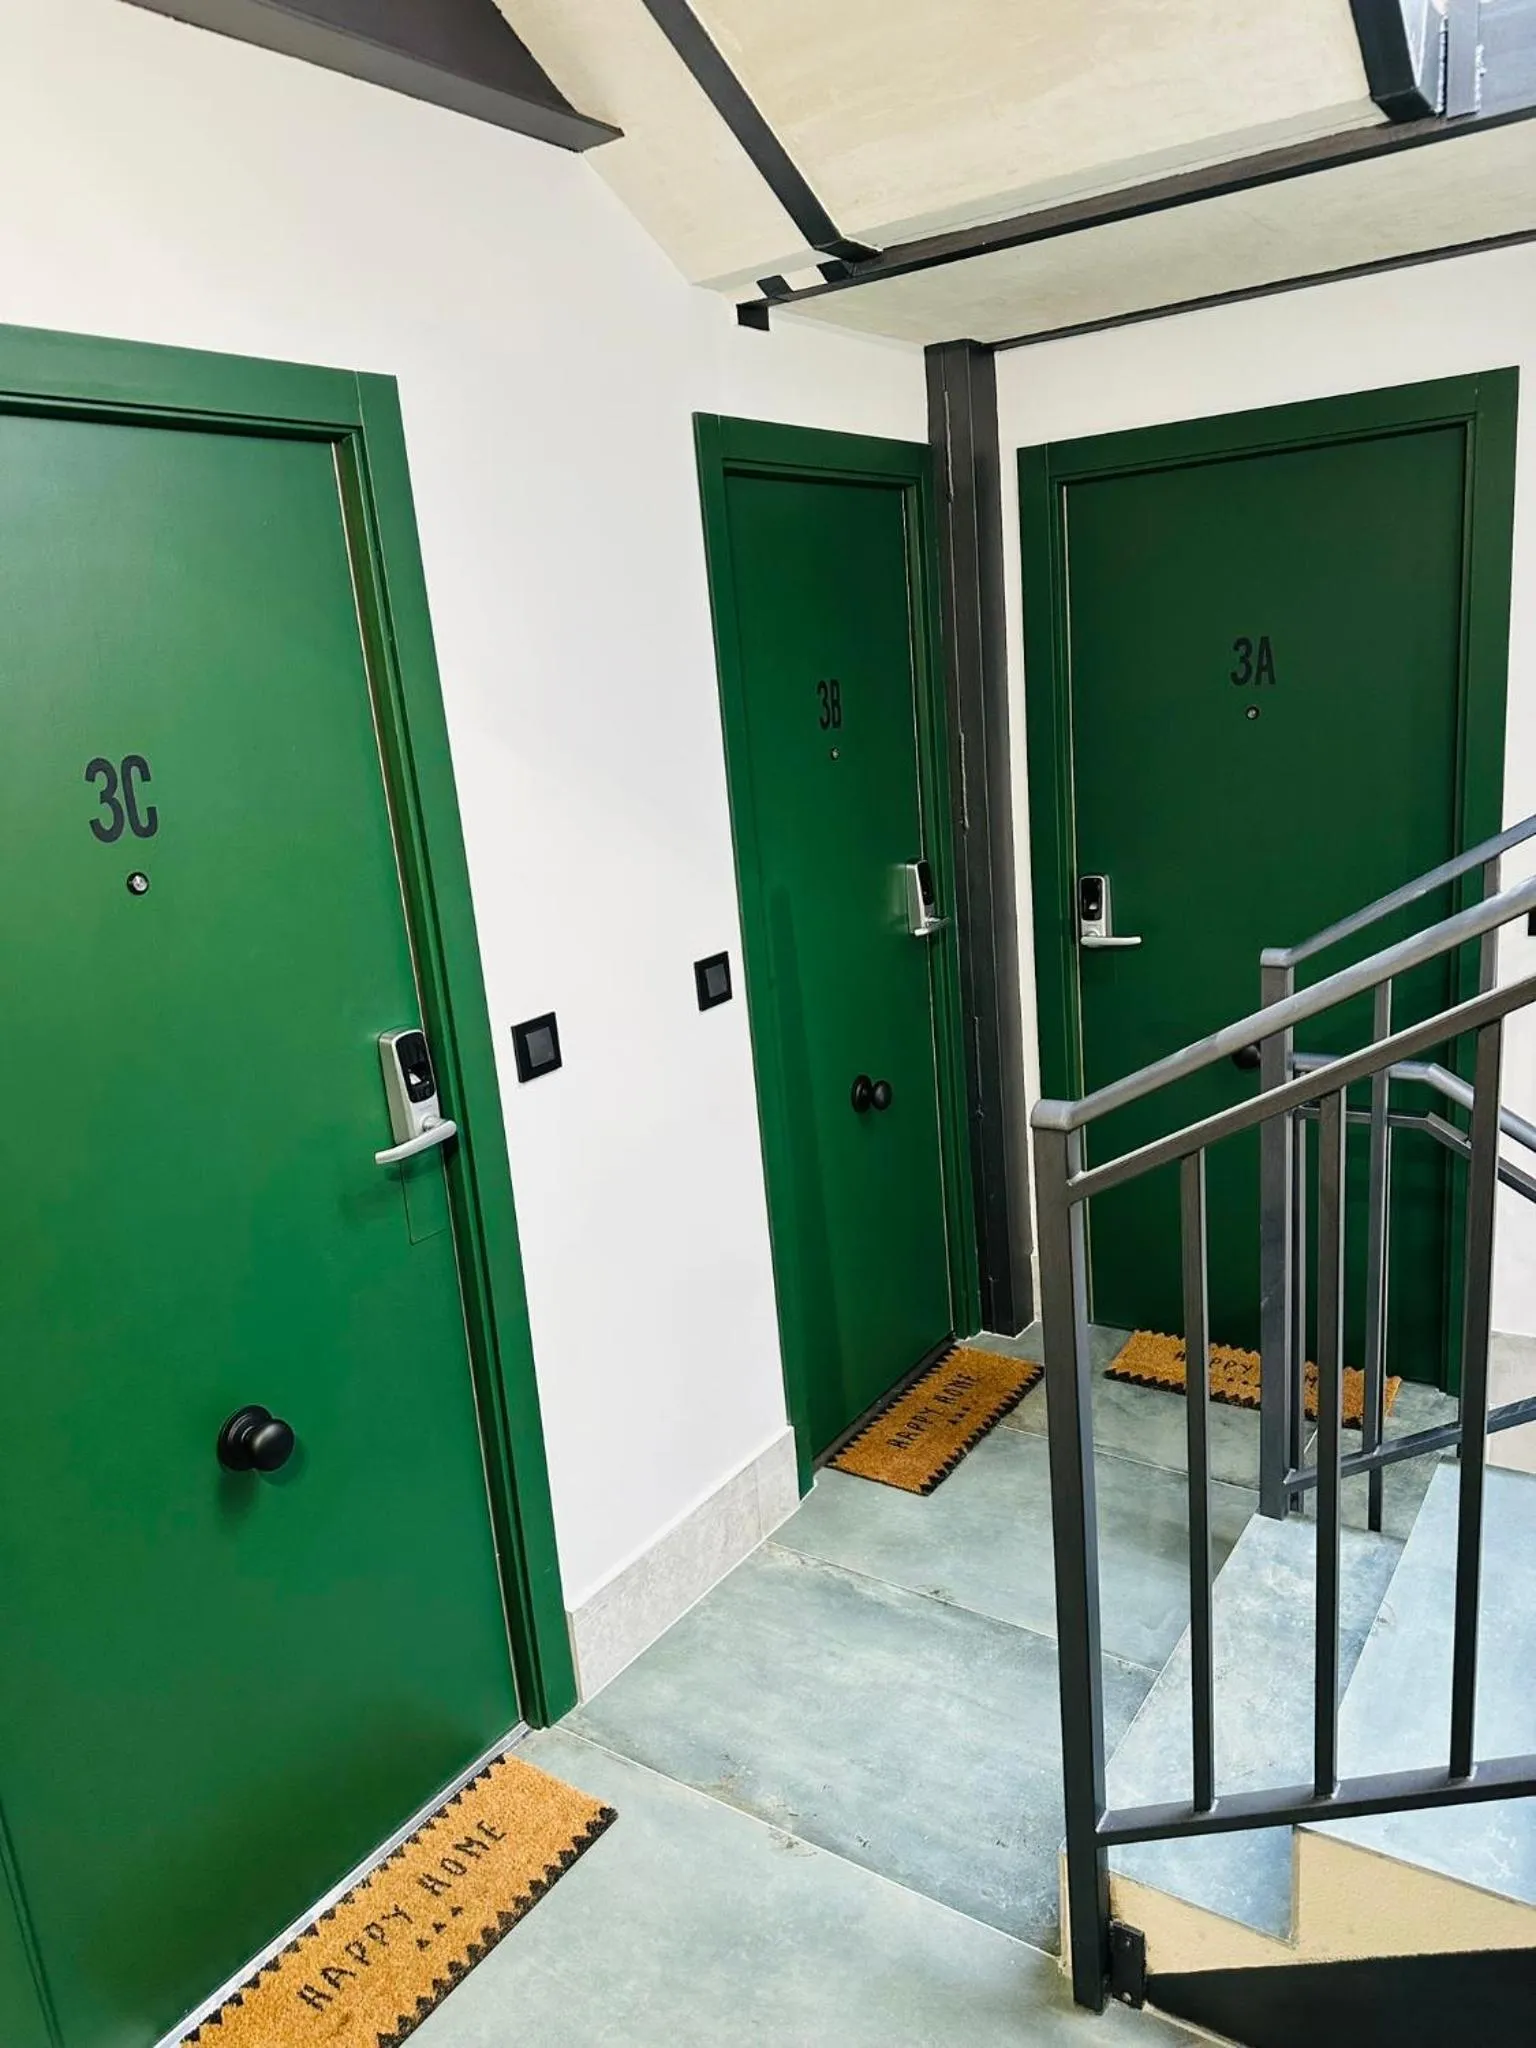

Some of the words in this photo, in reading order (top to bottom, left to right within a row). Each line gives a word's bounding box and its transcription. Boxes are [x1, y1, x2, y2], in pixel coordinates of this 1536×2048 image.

[1231, 636, 1276, 686] 3A
[817, 679, 842, 730] 3B
[85, 755, 158, 843] 3C
[1174, 1351, 1253, 1374] HPPY
[887, 1406, 940, 1449] HAPPY
[934, 1373, 978, 1404] HOME
[298, 1904, 413, 2011] HAPPY
[417, 1820, 506, 1896] HOME
